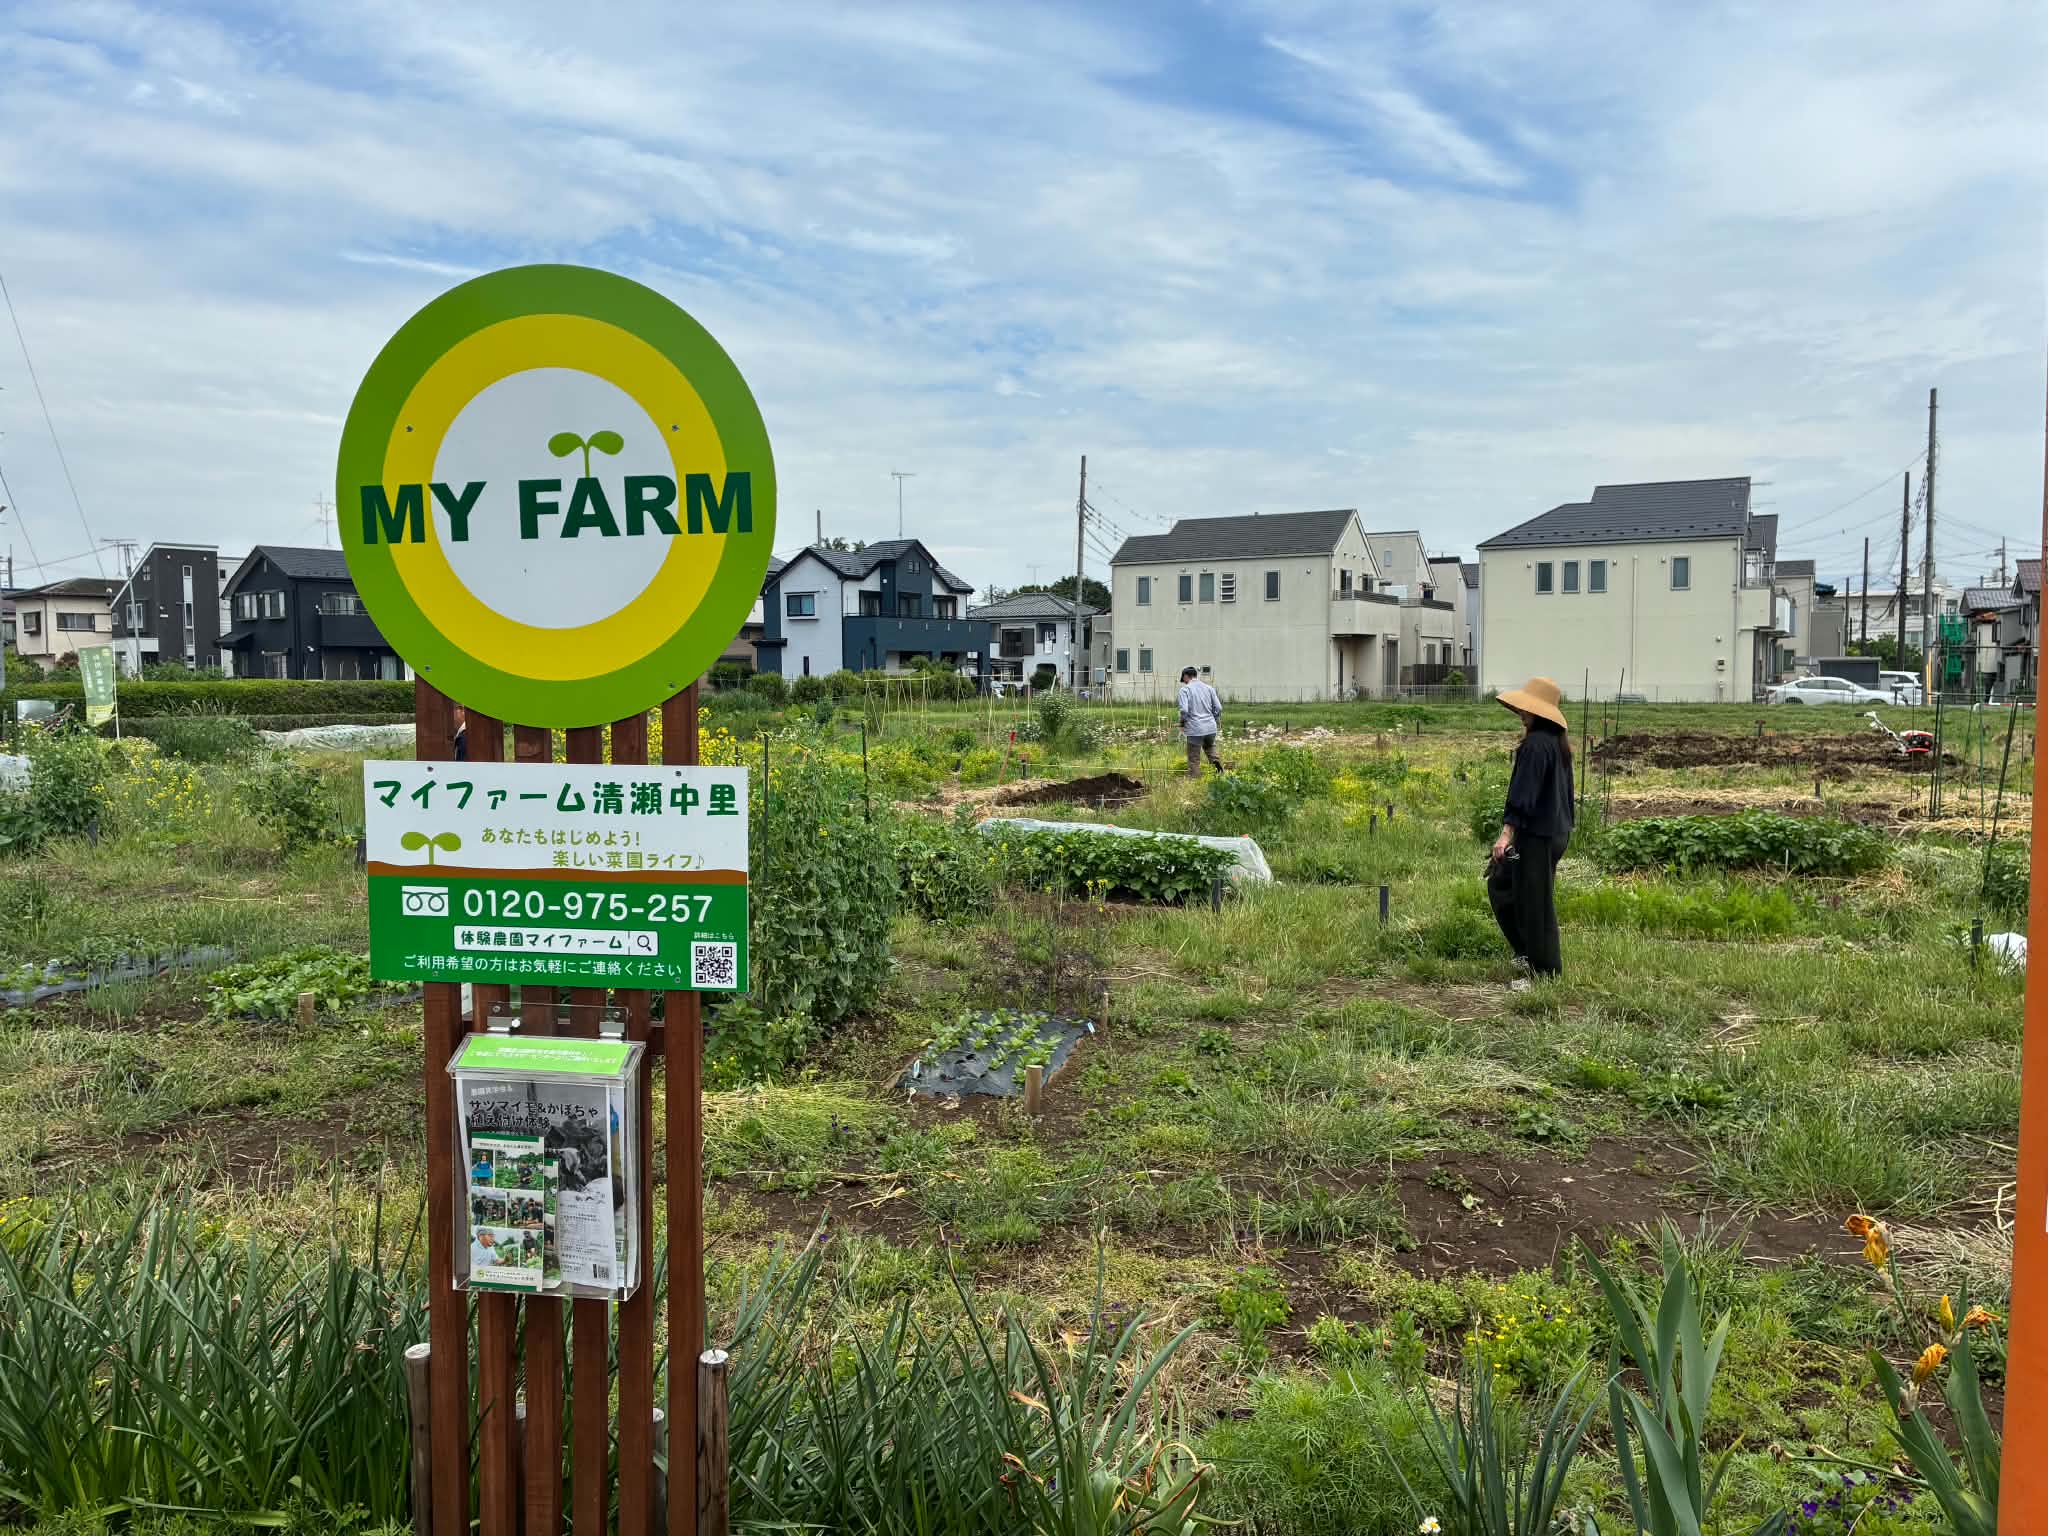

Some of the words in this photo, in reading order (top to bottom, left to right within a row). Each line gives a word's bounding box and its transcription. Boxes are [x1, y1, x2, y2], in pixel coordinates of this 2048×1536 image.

[360, 481, 487, 544] MY
[518, 472, 753, 540] FARM
[373, 780, 739, 816] マイファーム清瀬中里
[463, 888, 713, 923] 0120-975-257
[460, 930, 623, 950] 体験農園マイファーム
[403, 954, 682, 977] ご利用希望の方はお気軽にご連絡ください
